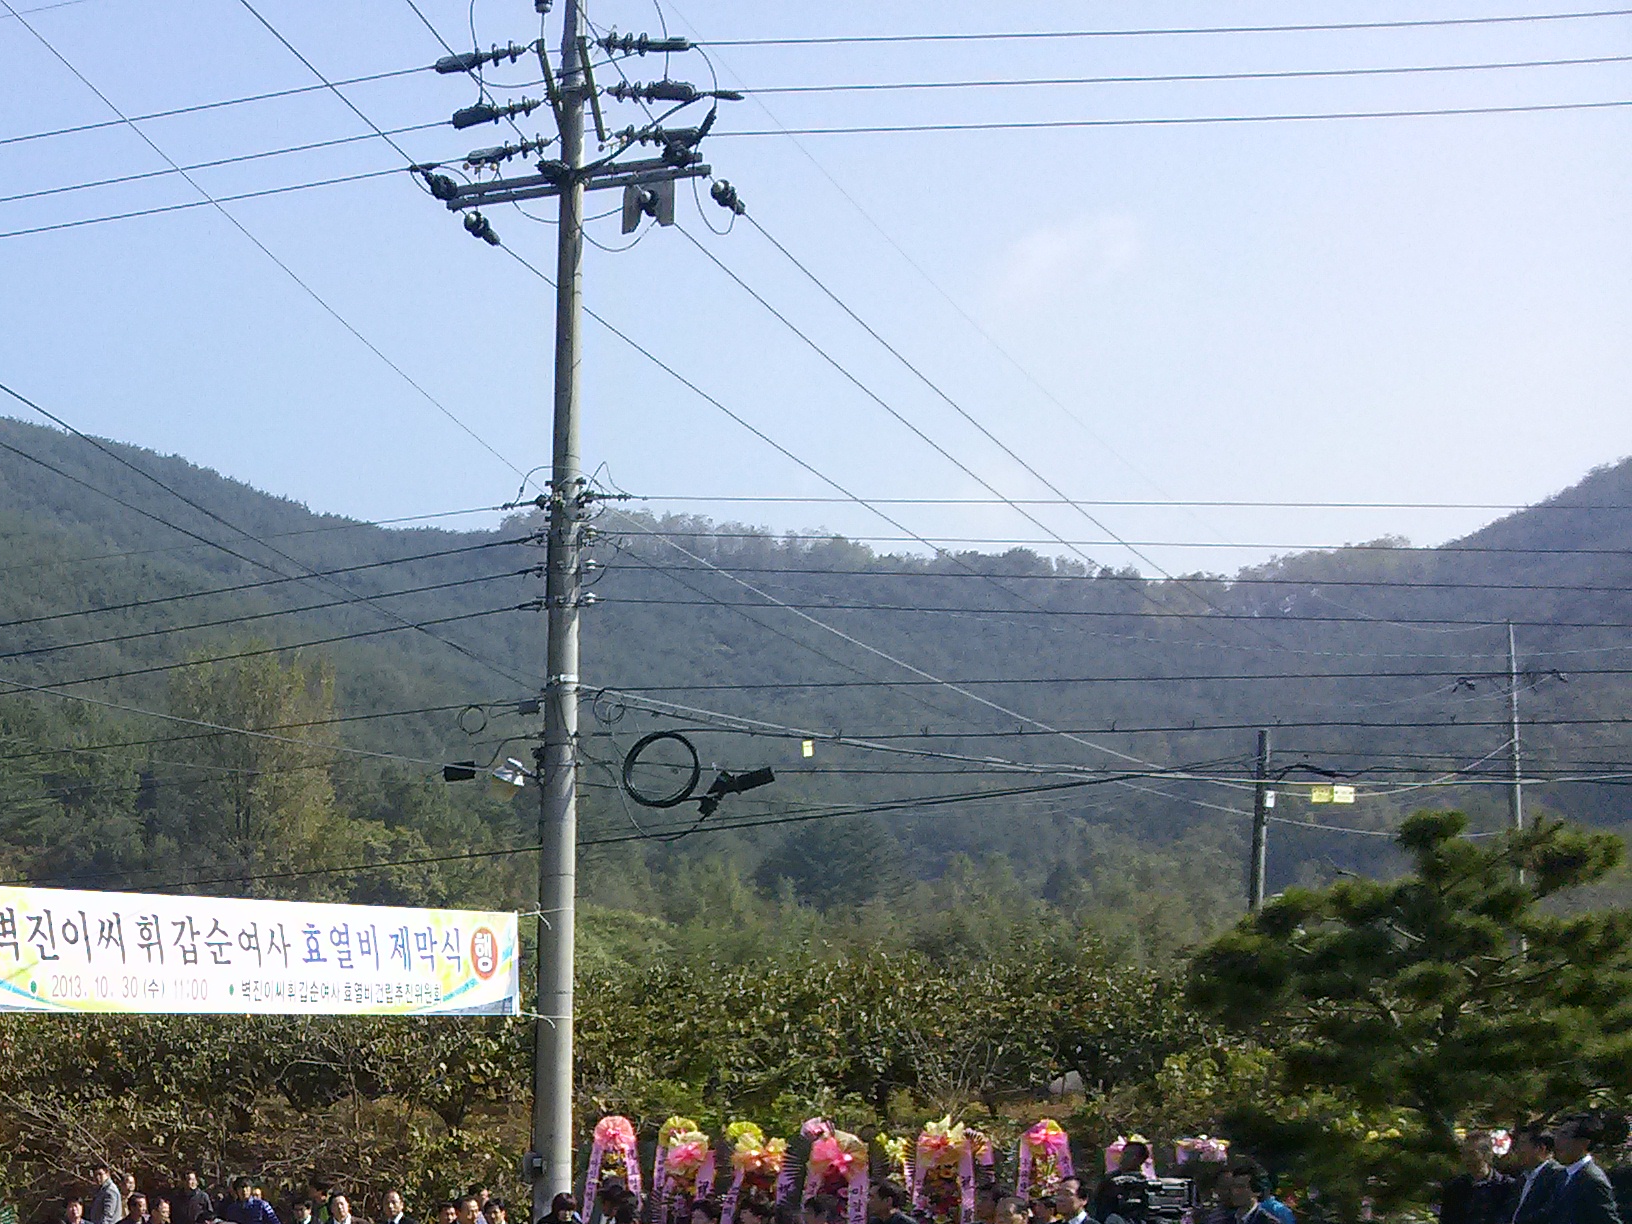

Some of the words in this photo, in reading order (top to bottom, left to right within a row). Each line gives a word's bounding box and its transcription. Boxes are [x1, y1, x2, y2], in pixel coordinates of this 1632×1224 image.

[301, 921, 380, 972] 효열비
[388, 925, 462, 974] 제막식
[474, 932, 494, 973] 행
[173, 977, 209, 1001] 11:00
